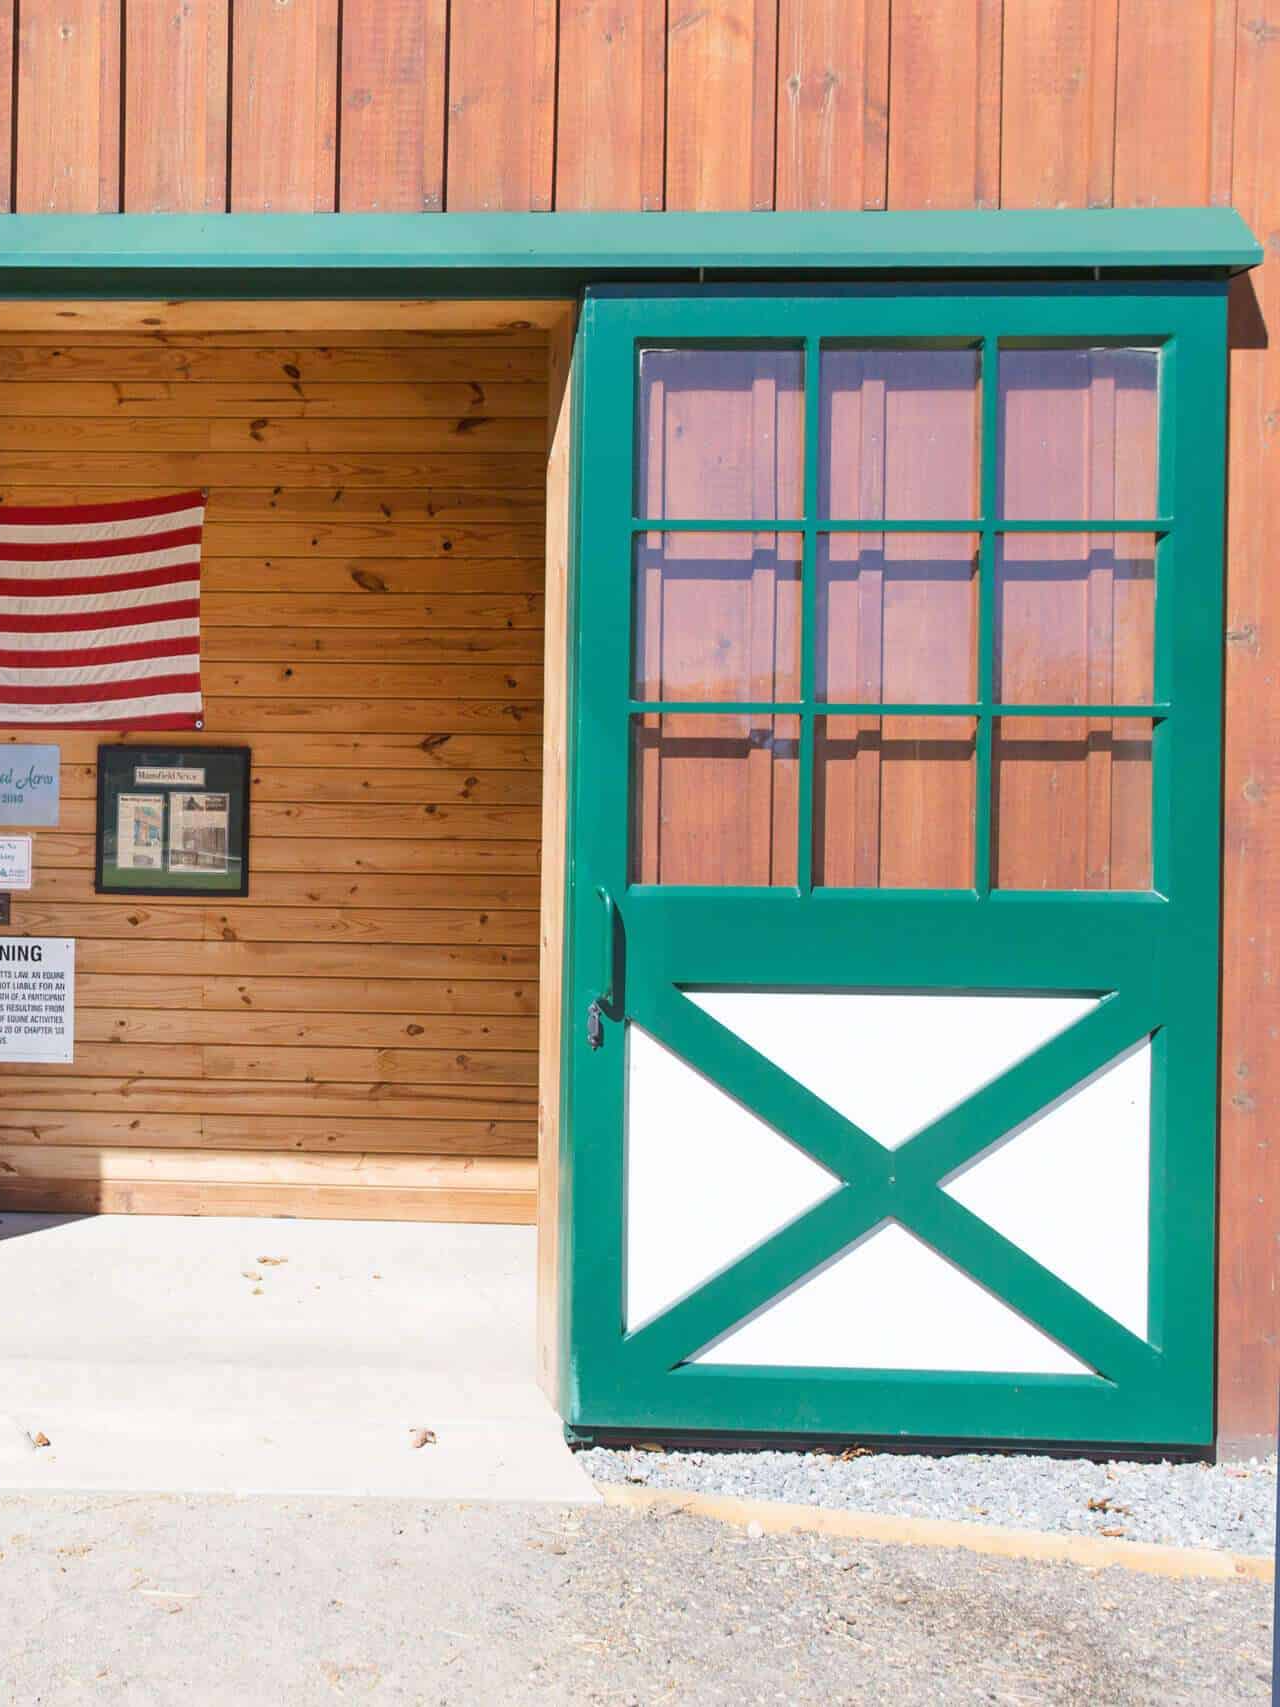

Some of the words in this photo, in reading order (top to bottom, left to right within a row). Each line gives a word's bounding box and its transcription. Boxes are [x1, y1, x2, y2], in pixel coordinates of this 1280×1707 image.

[31, 971, 41, 979] AN
[42, 971, 65, 980] EQUINE
[12, 982, 37, 990] LIABLE
[39, 982, 53, 991] FOR
[54, 983, 65, 991] AN
[21, 993, 26, 1001] A
[27, 993, 65, 1002] PARTICIPANT
[6, 1004, 43, 1012] RESULTING
[44, 1004, 65, 1012] FROM
[6, 1015, 29, 1023] EQUINE
[14, 1026, 22, 1034] OF
[23, 1026, 53, 1035] CHAPTER
